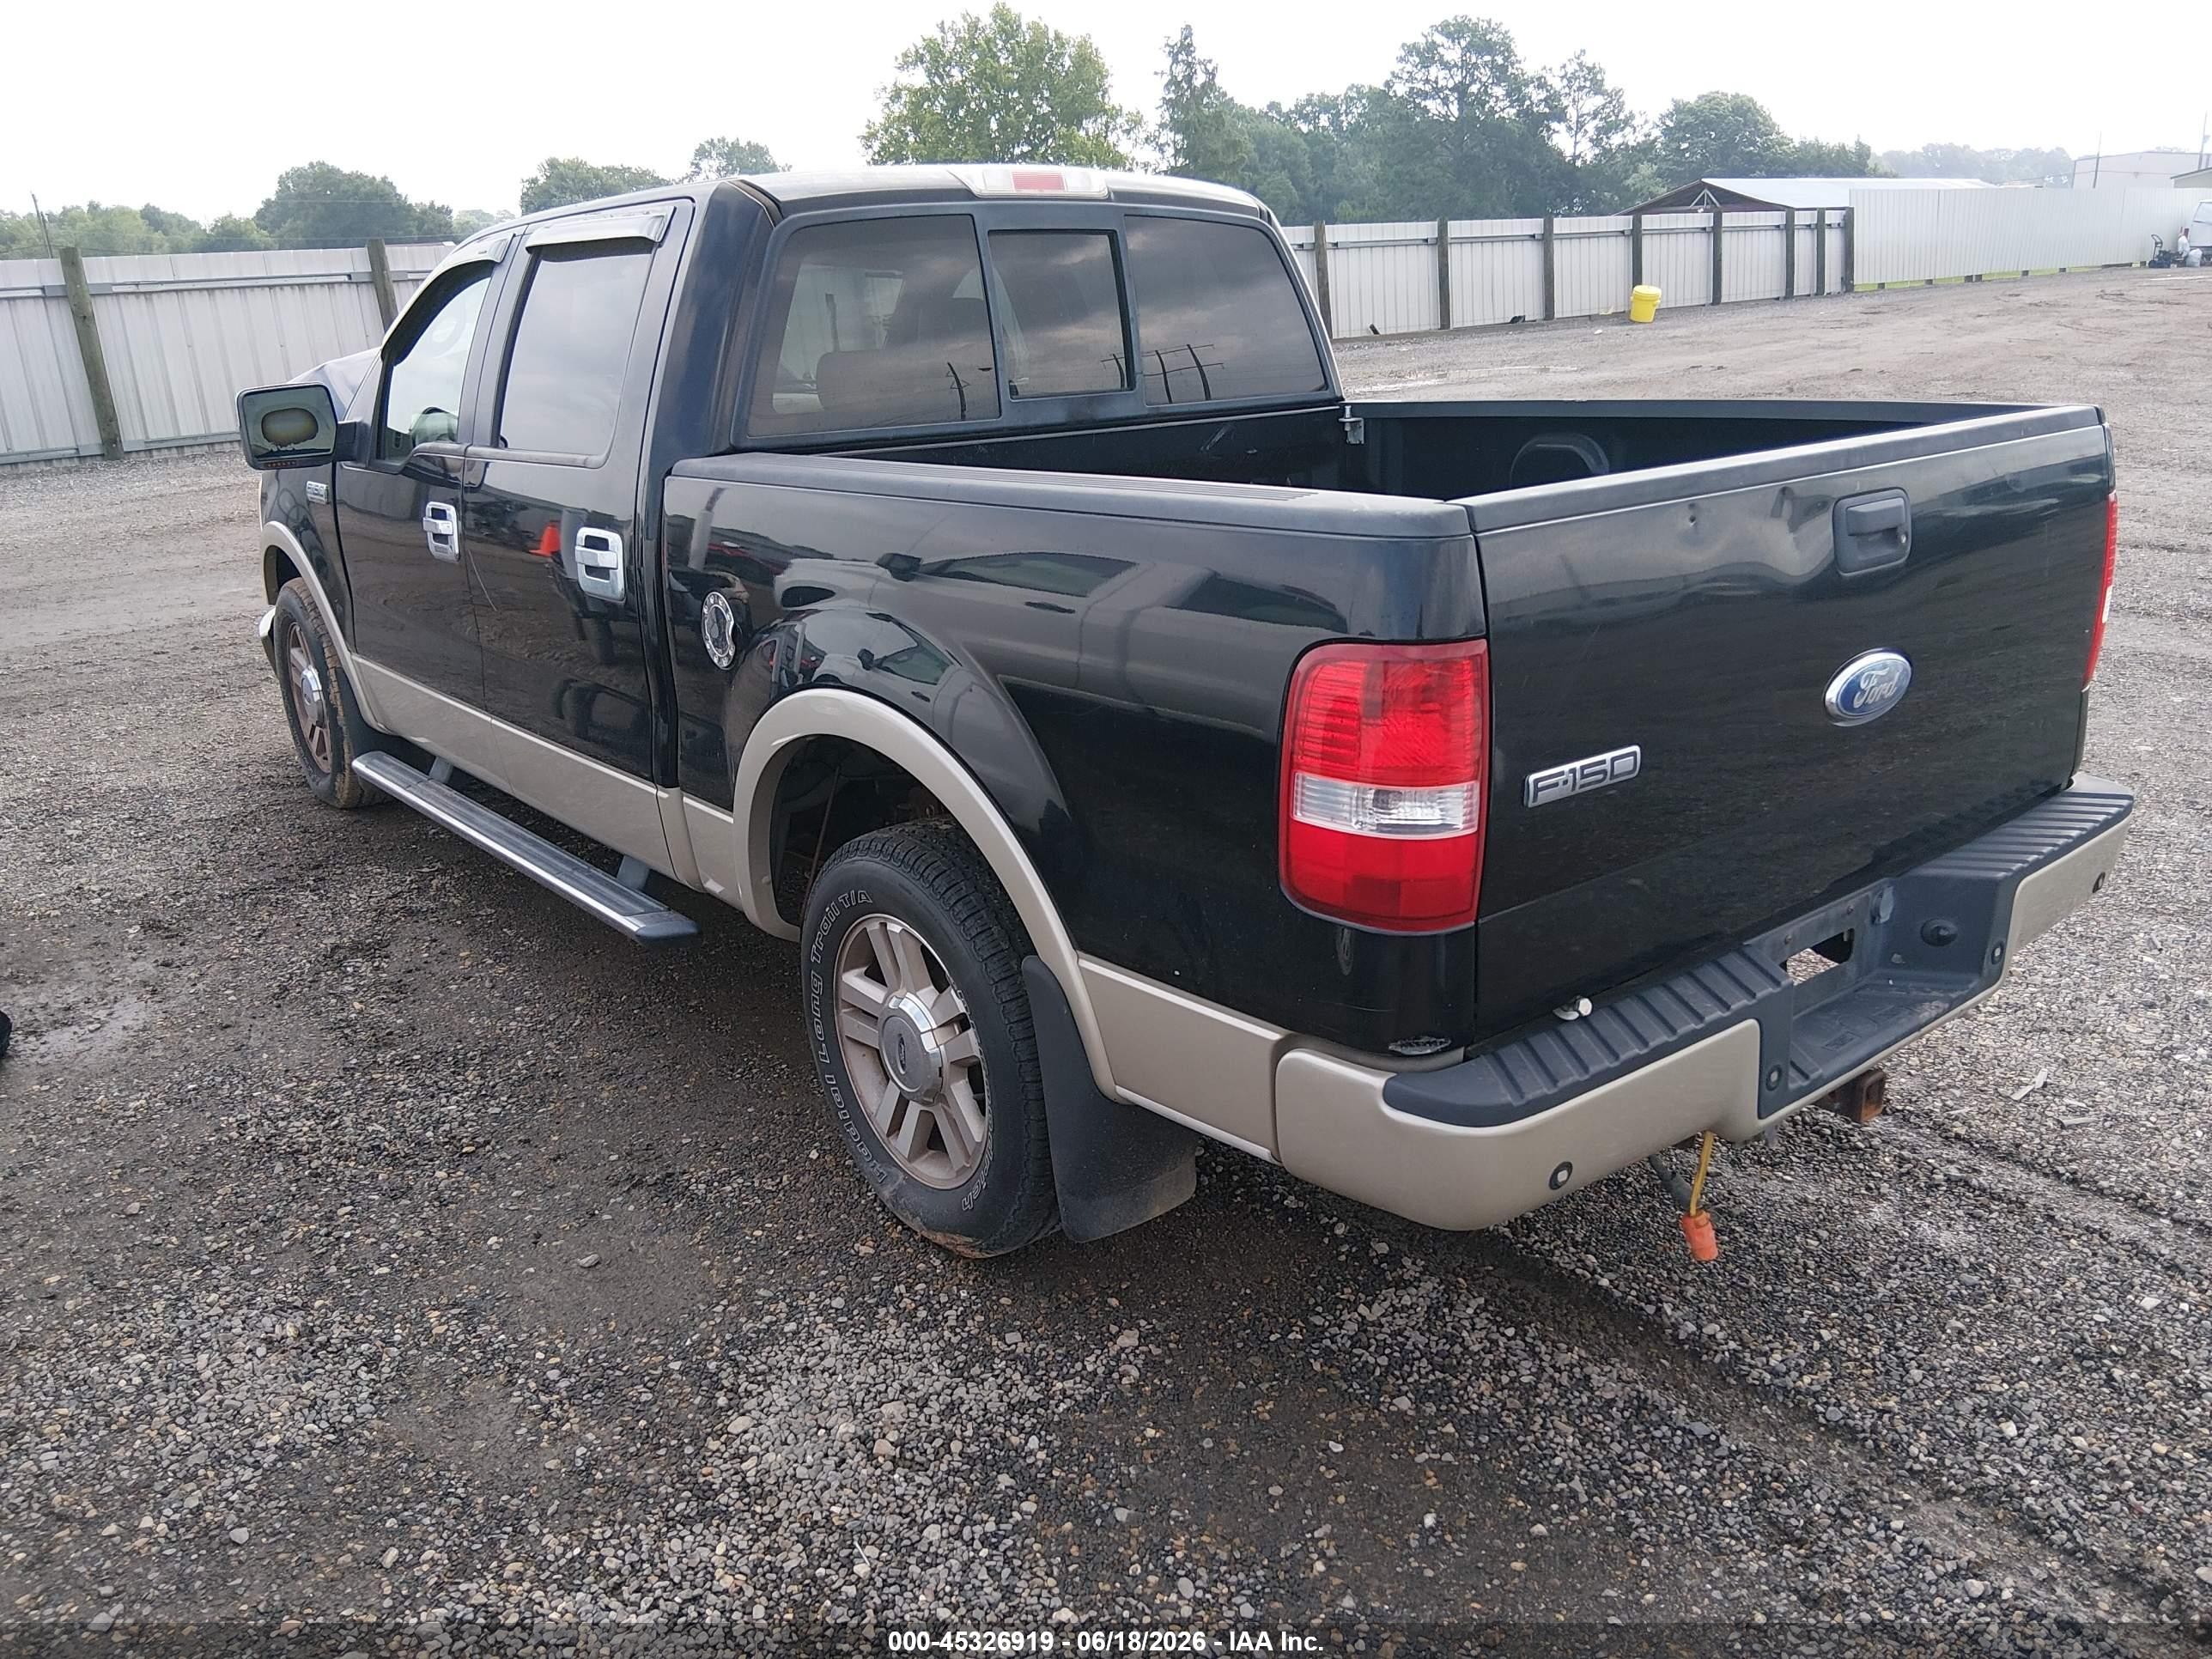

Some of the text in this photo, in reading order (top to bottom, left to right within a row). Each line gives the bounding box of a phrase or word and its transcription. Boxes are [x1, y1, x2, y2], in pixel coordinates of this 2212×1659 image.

[1853, 666, 1901, 708] Ford
[1531, 750, 1638, 804] F-150
[810, 890, 889, 1184] Radial Long Trail T/A
